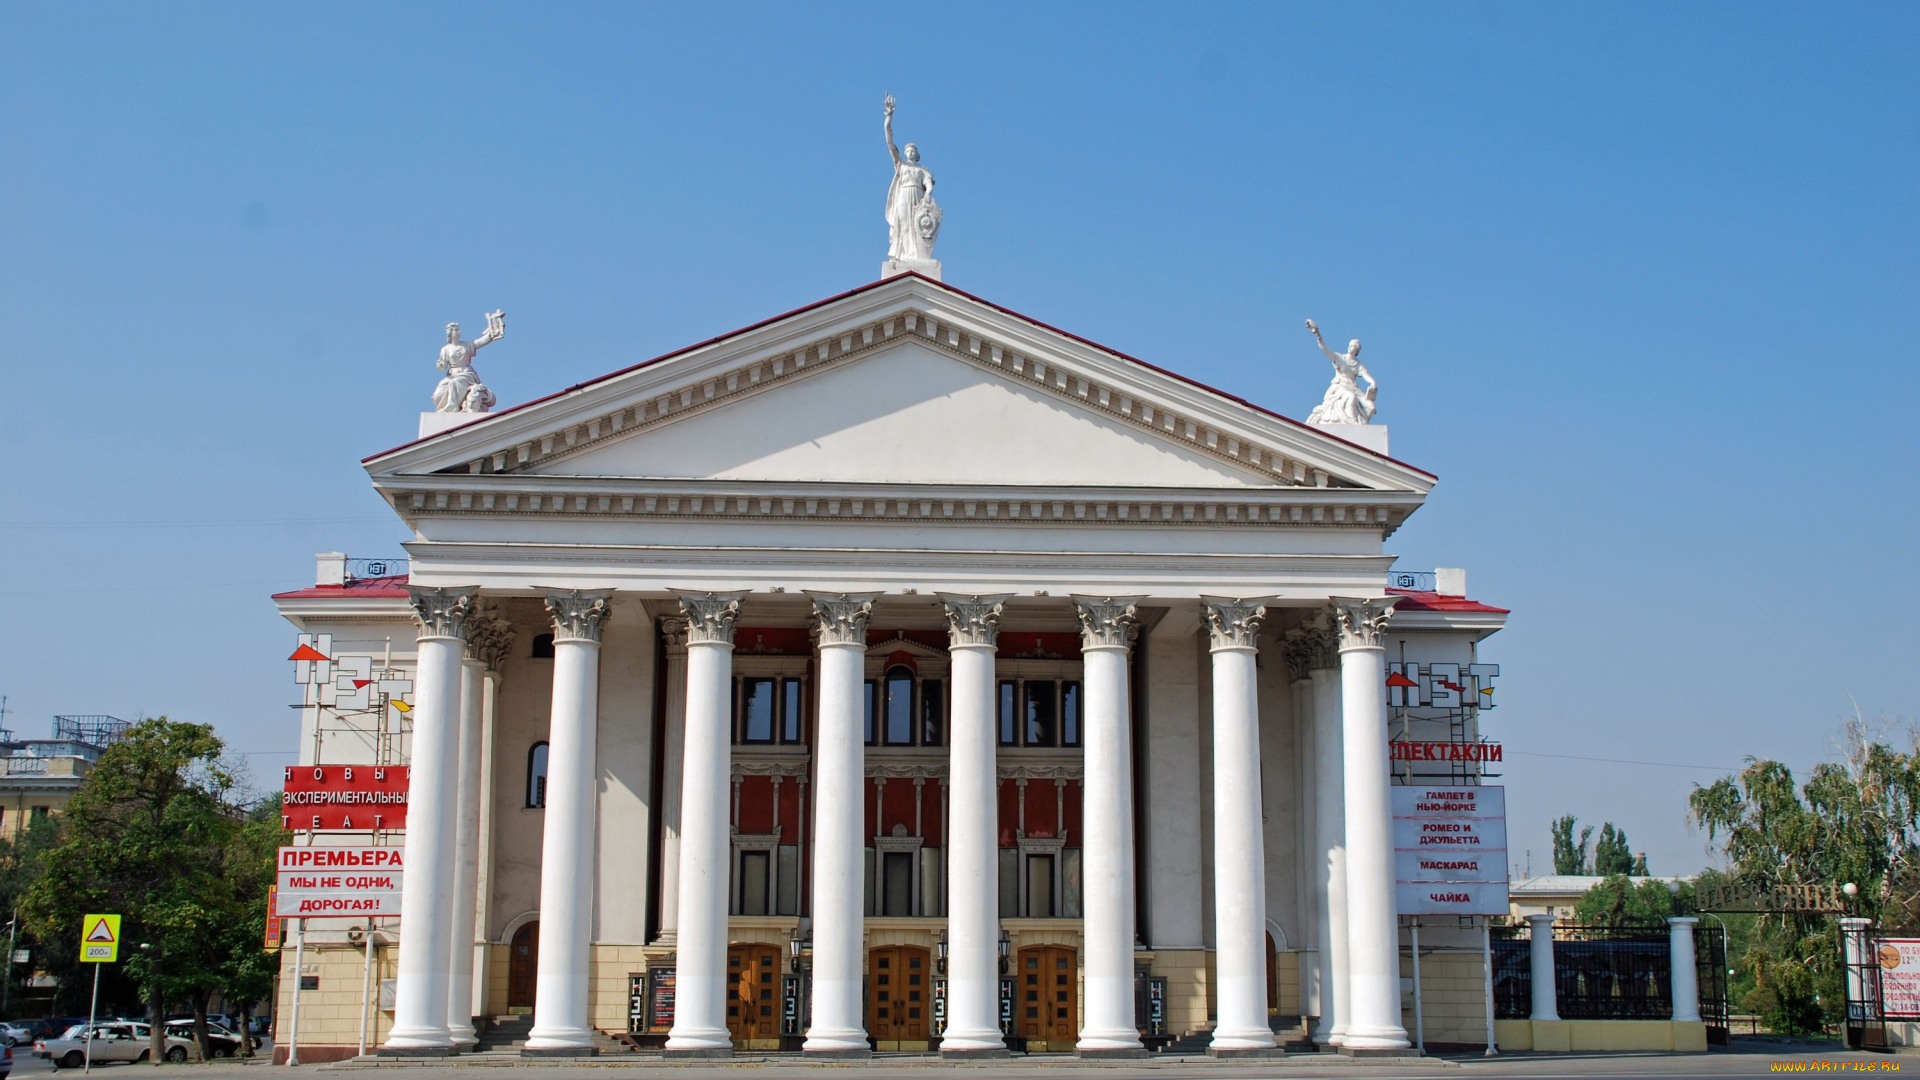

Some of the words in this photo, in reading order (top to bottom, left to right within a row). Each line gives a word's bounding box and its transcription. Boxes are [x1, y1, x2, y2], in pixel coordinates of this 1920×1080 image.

[1426, 792, 1465, 800] ГАМЛЕТ
[1467, 792, 1475, 800] В
[1416, 802, 1476, 811] НЬЮ-ЙОРКЕ
[282, 815, 408, 828] ТЕАТ
[1423, 824, 1460, 832] РОМЕО
[1463, 824, 1471, 832] И
[1419, 836, 1480, 845] ДЖУЛЬЕТТА
[283, 851, 403, 866] ПРЕМЬЕРА
[1420, 862, 1478, 871] МАСКАРАД
[289, 877, 316, 888] МЫ
[320, 877, 341, 888] НЕ
[345, 877, 394, 889] ОДНИ,
[1430, 892, 1470, 902] ЧАЙКА
[1696, 884, 1744, 911] BAR
